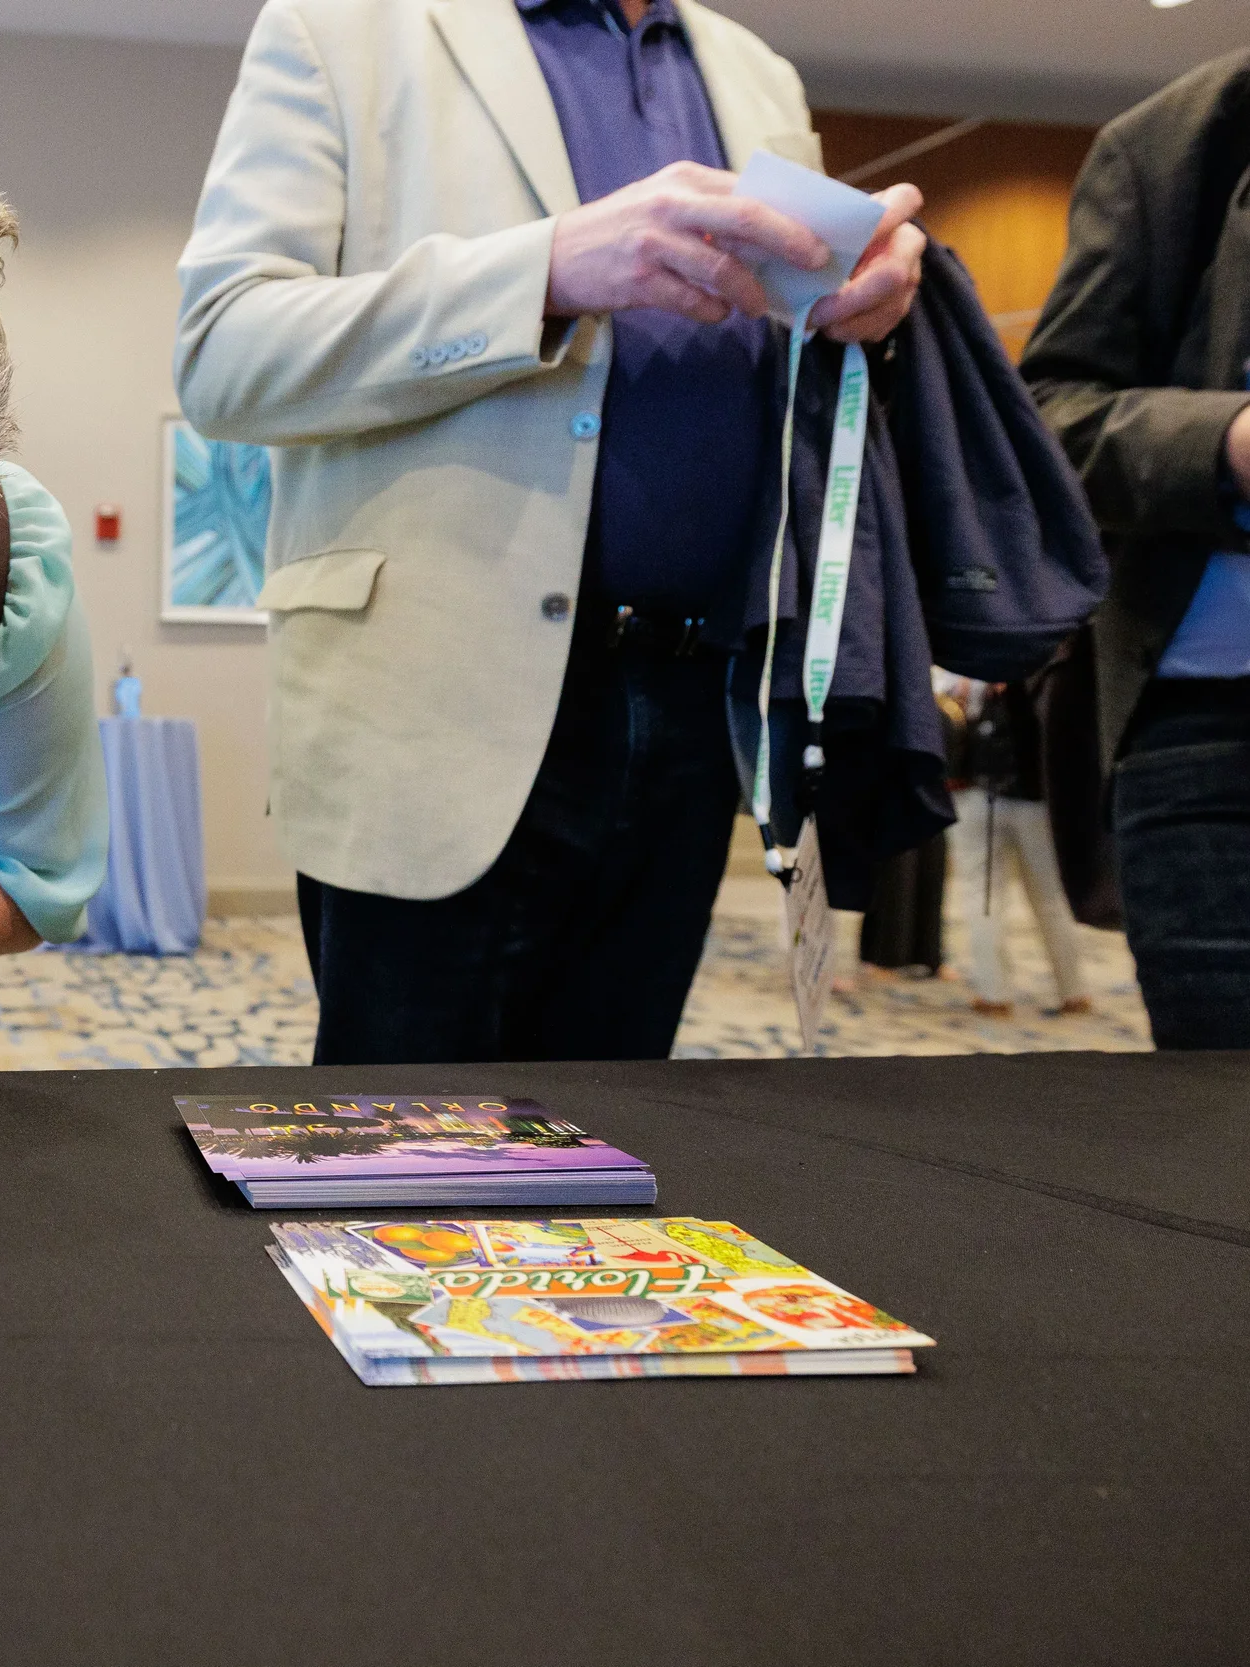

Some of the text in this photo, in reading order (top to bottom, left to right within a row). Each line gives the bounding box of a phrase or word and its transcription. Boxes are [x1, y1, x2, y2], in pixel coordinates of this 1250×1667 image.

[827, 465, 857, 533] Littler
[815, 560, 845, 627] Littler
[249, 1100, 508, 1114] ORLANDO
[425, 1263, 726, 1301] Florida
